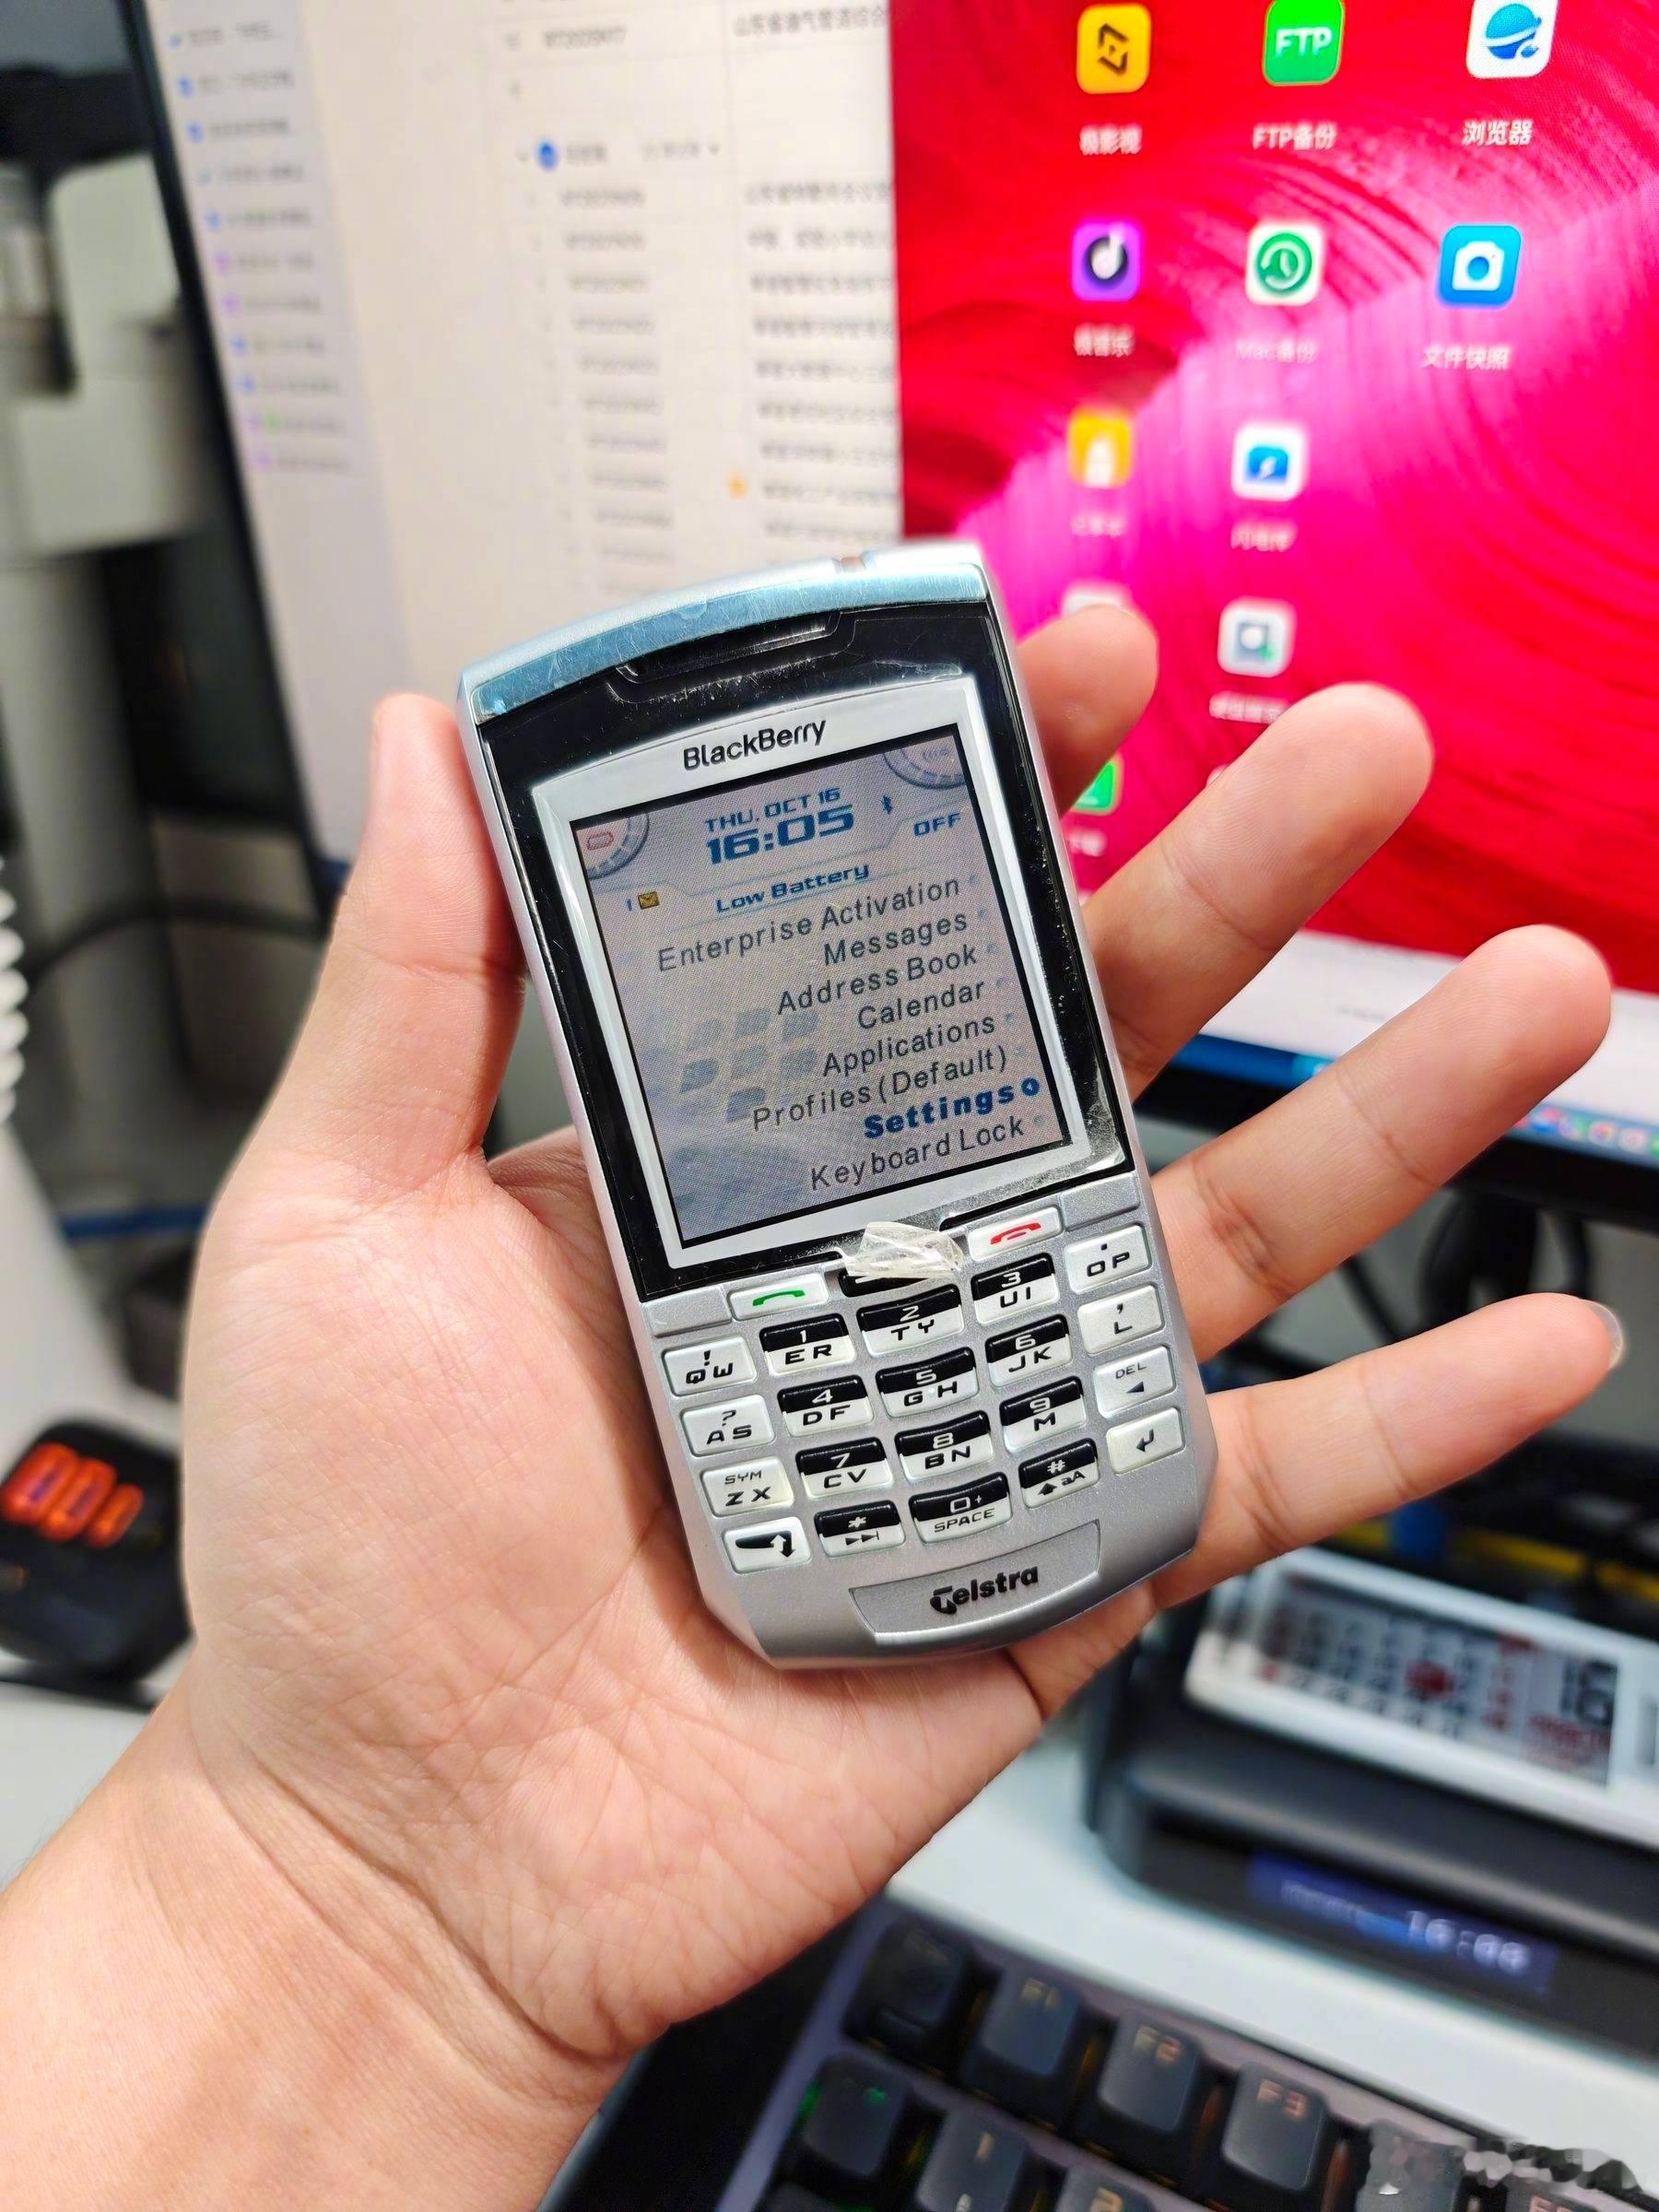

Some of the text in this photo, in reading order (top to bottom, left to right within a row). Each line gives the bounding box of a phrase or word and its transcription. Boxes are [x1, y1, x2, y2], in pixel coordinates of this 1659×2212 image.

[1276, 26, 1333, 56] FTP
[1253, 122, 1335, 150] FTP备份
[1462, 119, 1534, 147] 浏览器
[1422, 341, 1510, 371] 文件快照
[683, 720, 826, 771] BlackBerry
[705, 787, 841, 832] THU. OCT 16
[706, 804, 854, 865] 16:05
[913, 813, 960, 837] OFF
[715, 865, 869, 913] Low Battery
[658, 878, 959, 971] Enterprise Activation
[824, 913, 968, 965] Messages
[778, 944, 977, 1015] Address Book
[858, 982, 984, 1029] Calendar
[823, 1016, 995, 1077] Applications
[753, 1045, 1007, 1131] Profiles (Default)
[864, 1086, 1015, 1139] Settings
[811, 1115, 1024, 1191] Keyboard Lock
[1001, 1271, 1021, 1288] 3
[900, 1305, 920, 1322] 2
[800, 1330, 807, 1343] 1
[1015, 1334, 1036, 1350] 6
[1113, 1322, 1133, 1335] L
[915, 1369, 937, 1385] 5
[1115, 1362, 1147, 1380] DEL
[812, 1389, 833, 1404] 4
[1030, 1396, 1051, 1414] 9
[1033, 1412, 1056, 1431] M
[932, 1432, 954, 1450] 8
[830, 1453, 851, 1469] 7
[724, 1470, 762, 1485] SYM
[1061, 1470, 1087, 1487] aA
[934, 1508, 995, 1534] SPACE
[929, 1566, 1039, 1615] Telstra
[1134, 2025, 1182, 2064] F2
[1256, 2079, 1309, 2121] F3
